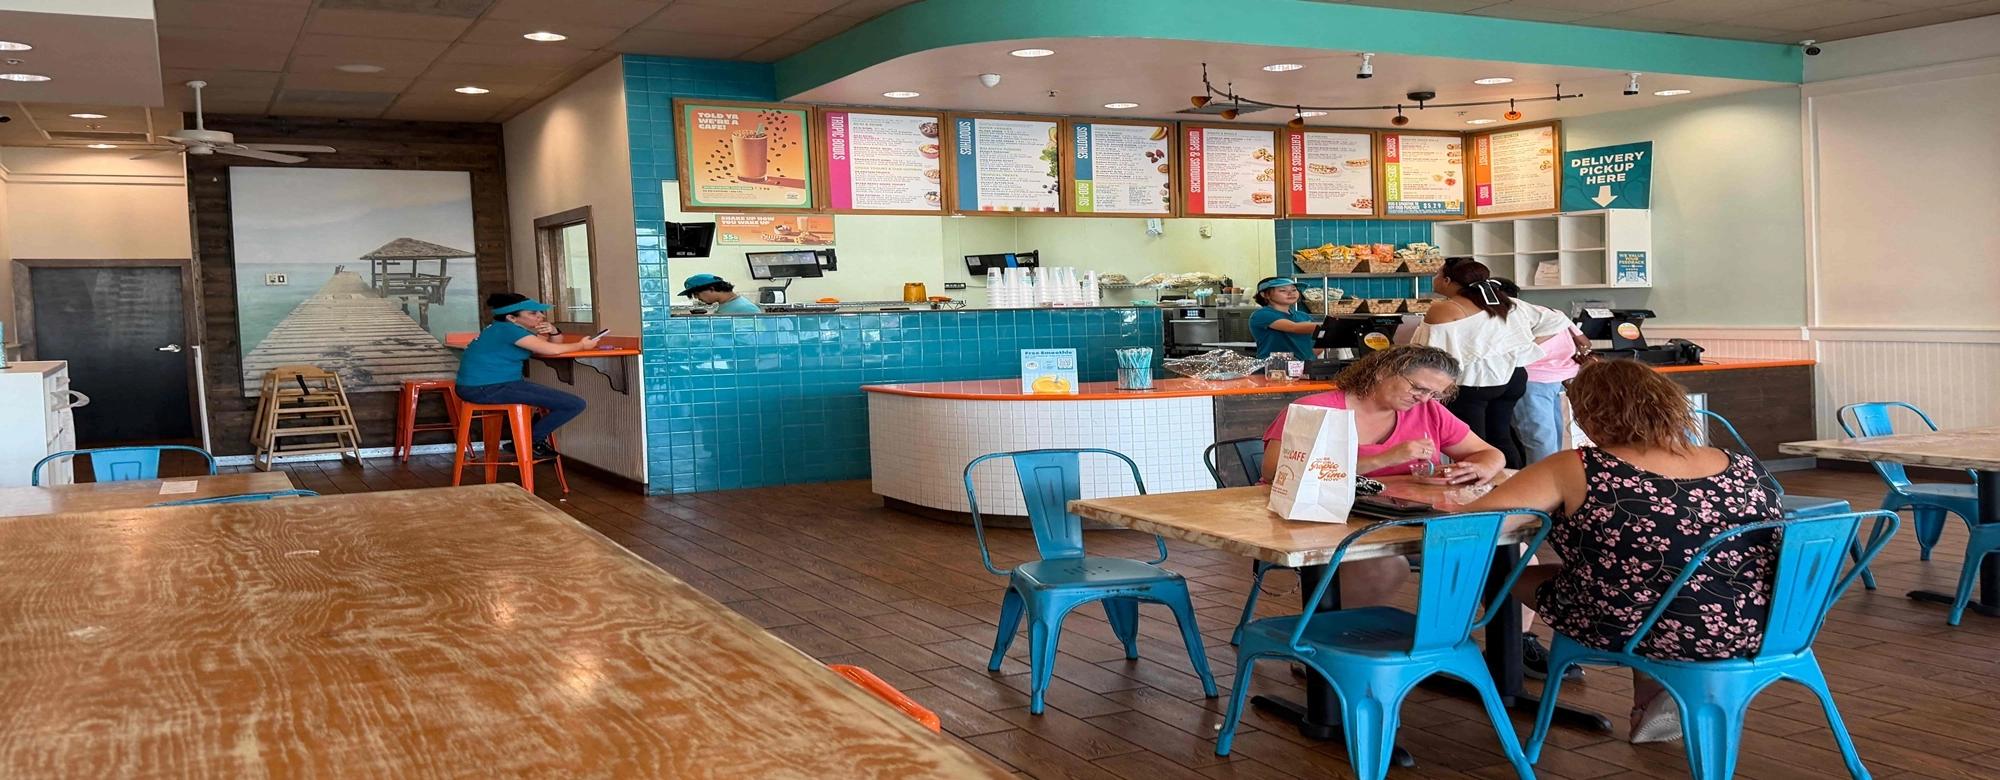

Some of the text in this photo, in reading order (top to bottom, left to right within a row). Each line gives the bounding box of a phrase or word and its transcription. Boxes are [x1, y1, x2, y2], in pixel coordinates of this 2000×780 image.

[831, 116, 845, 160] TROPIC BOWLS
[959, 121, 972, 155] SMOOTHIES
[1077, 126, 1088, 159] SMOOTHIES
[1190, 131, 1200, 151] WRAPS
[1387, 138, 1396, 158] SNACKS
[1291, 134, 1302, 166] FLATBREADS
[1478, 138, 1488, 166] BREAKFAST
[1571, 151, 1645, 168] DELIVERY
[1190, 158, 1201, 193] SANDWICHES
[1580, 163, 1634, 176] PICKUP
[1586, 173, 1626, 184] HERE
[1079, 183, 1089, 206] ADD-INS
[1480, 186, 1489, 199] KIDS
[1289, 450, 1306, 462] CAFE
[1318, 469, 1347, 479] Time
